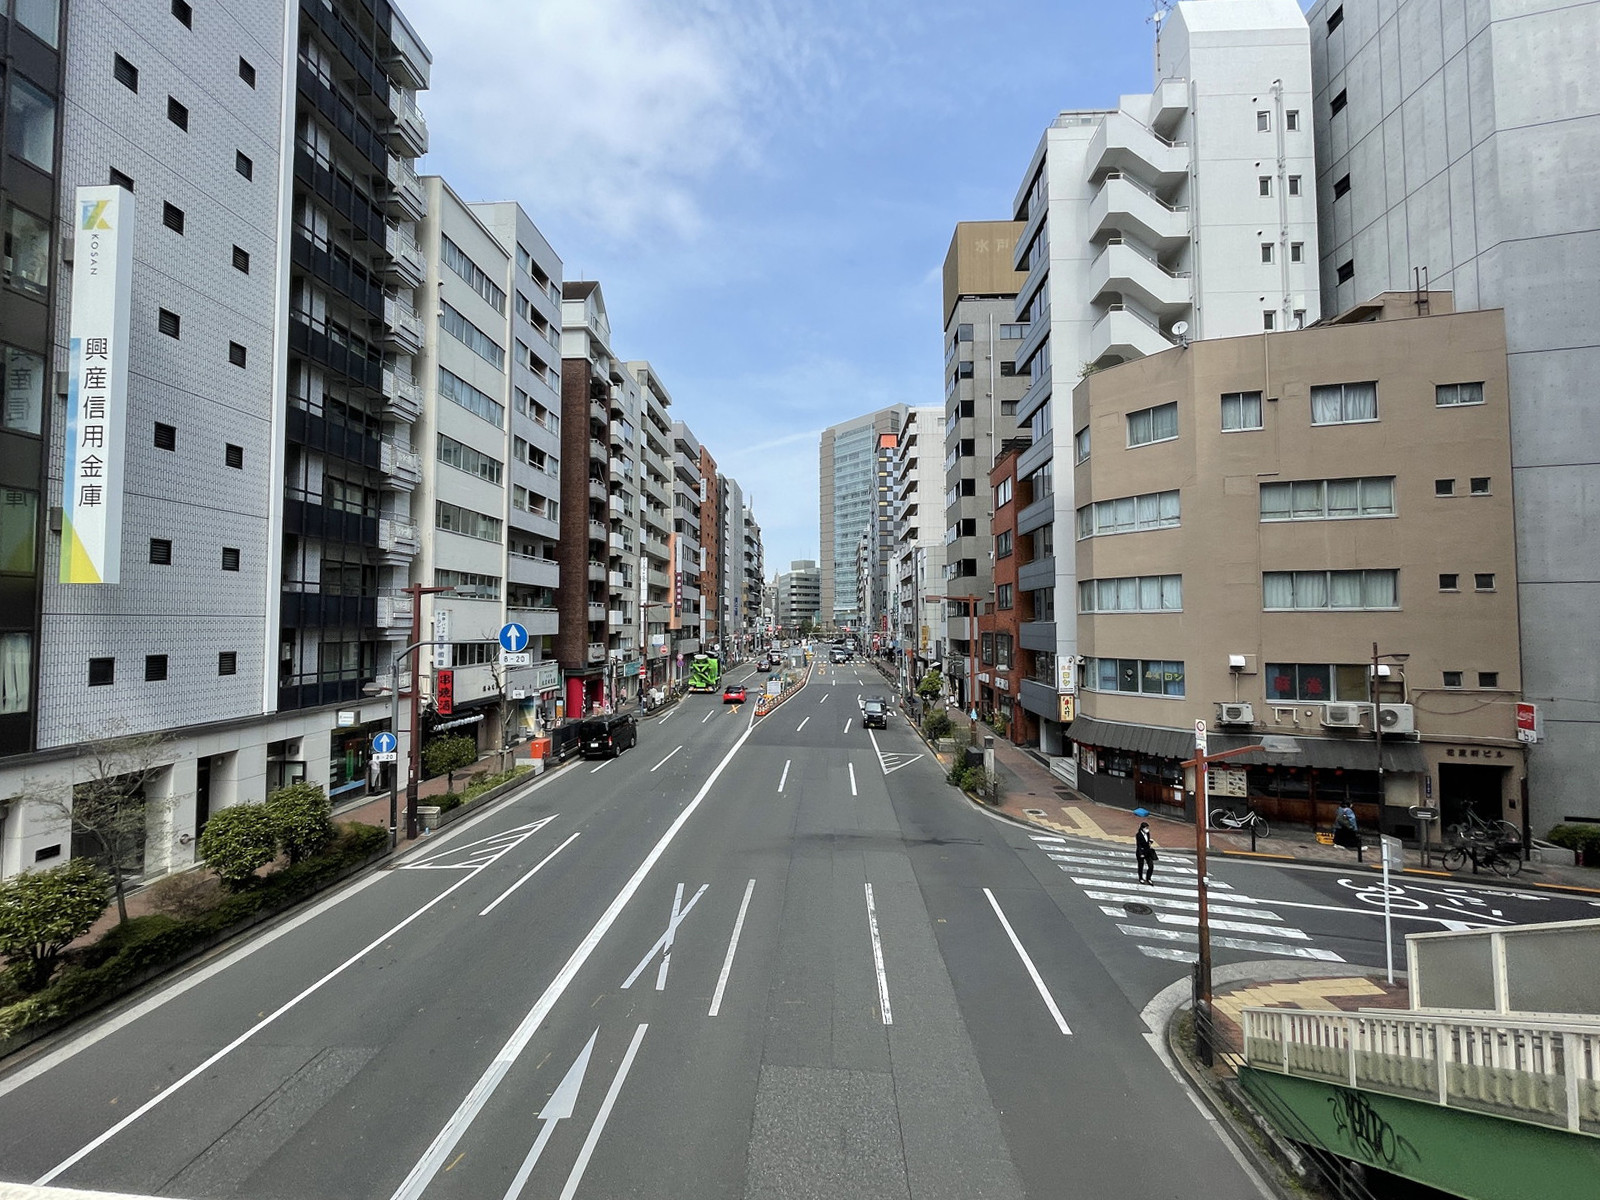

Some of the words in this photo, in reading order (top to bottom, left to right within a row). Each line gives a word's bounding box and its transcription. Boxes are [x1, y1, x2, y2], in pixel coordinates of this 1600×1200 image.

[90, 233, 100, 276] KOSAN
[975, 238, 1018, 253] 水戸
[78, 336, 109, 508] 興産信用金庫
[503, 655, 526, 663] 8-20
